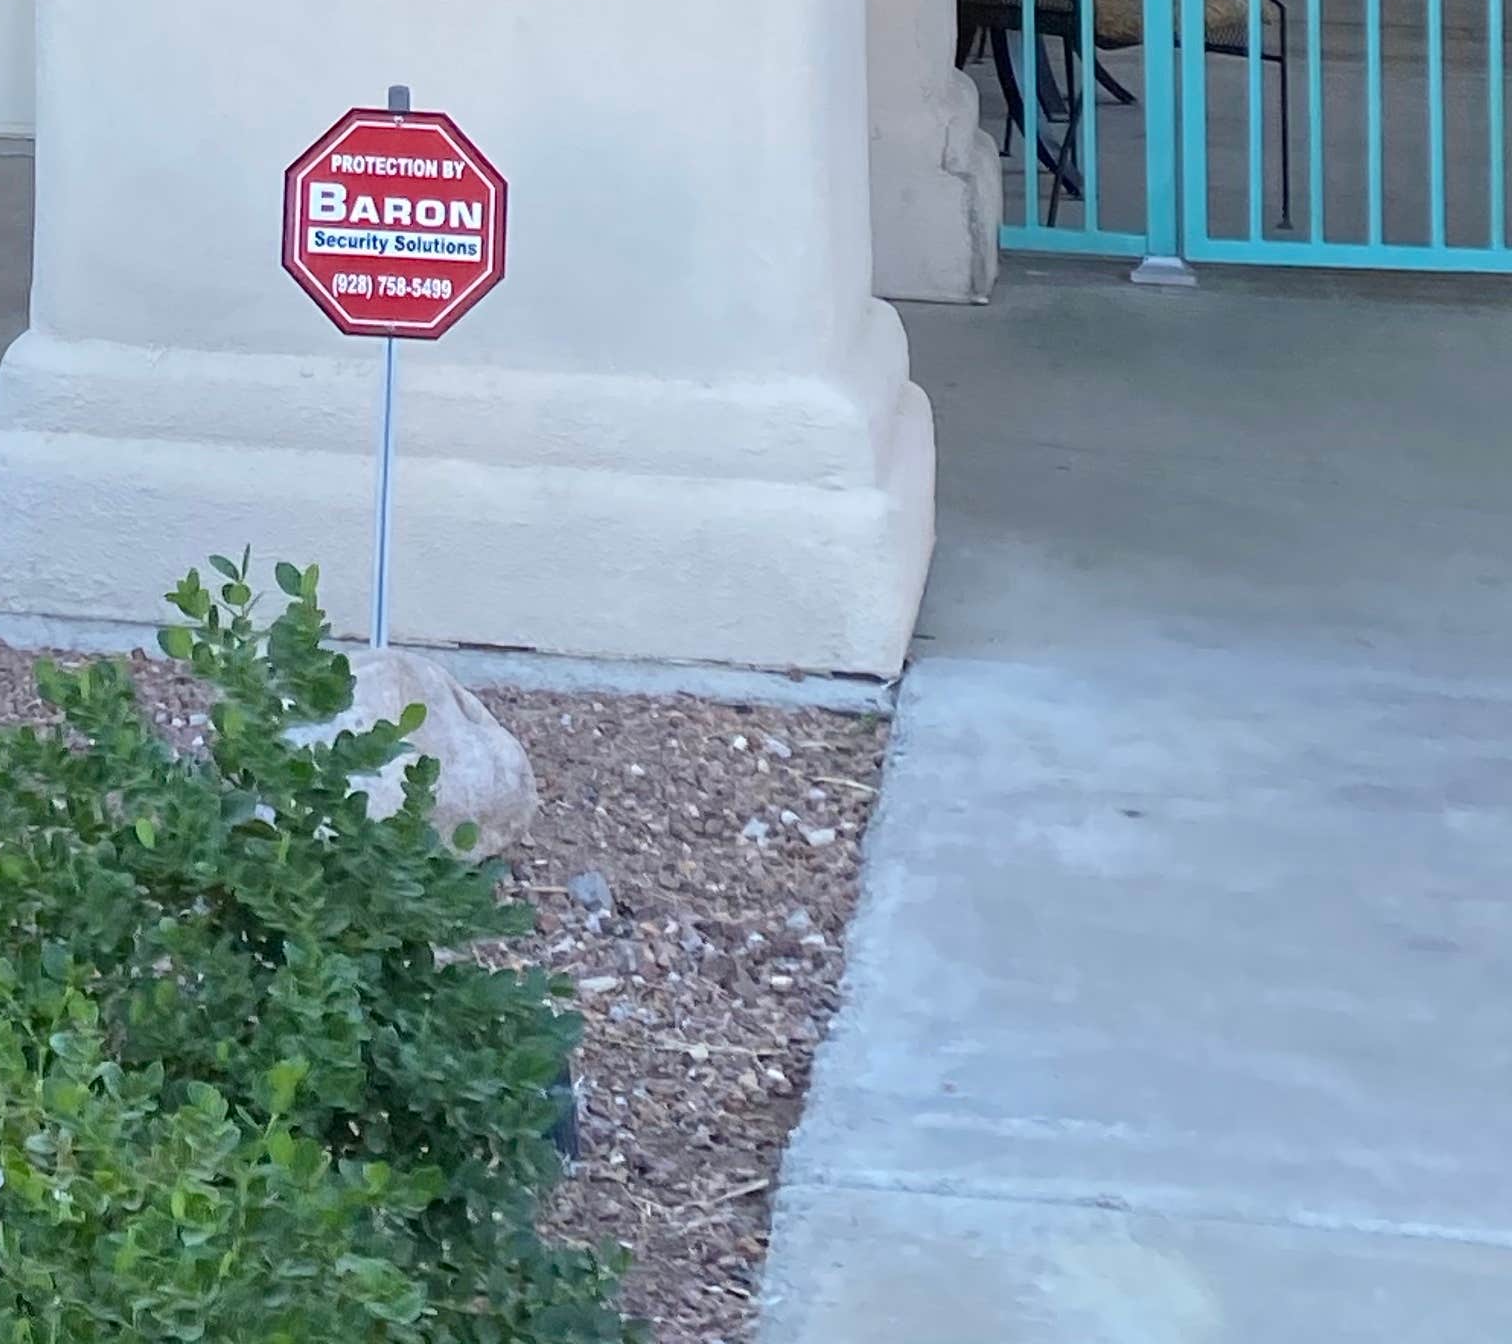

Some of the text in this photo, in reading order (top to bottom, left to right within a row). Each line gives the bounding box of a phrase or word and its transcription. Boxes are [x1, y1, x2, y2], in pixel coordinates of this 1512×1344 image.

[331, 154, 466, 180] PROTECTION BY
[308, 181, 483, 230] BARON
[314, 230, 478, 257] Security Solutions
[332, 273, 453, 300] (928) 758-5499
